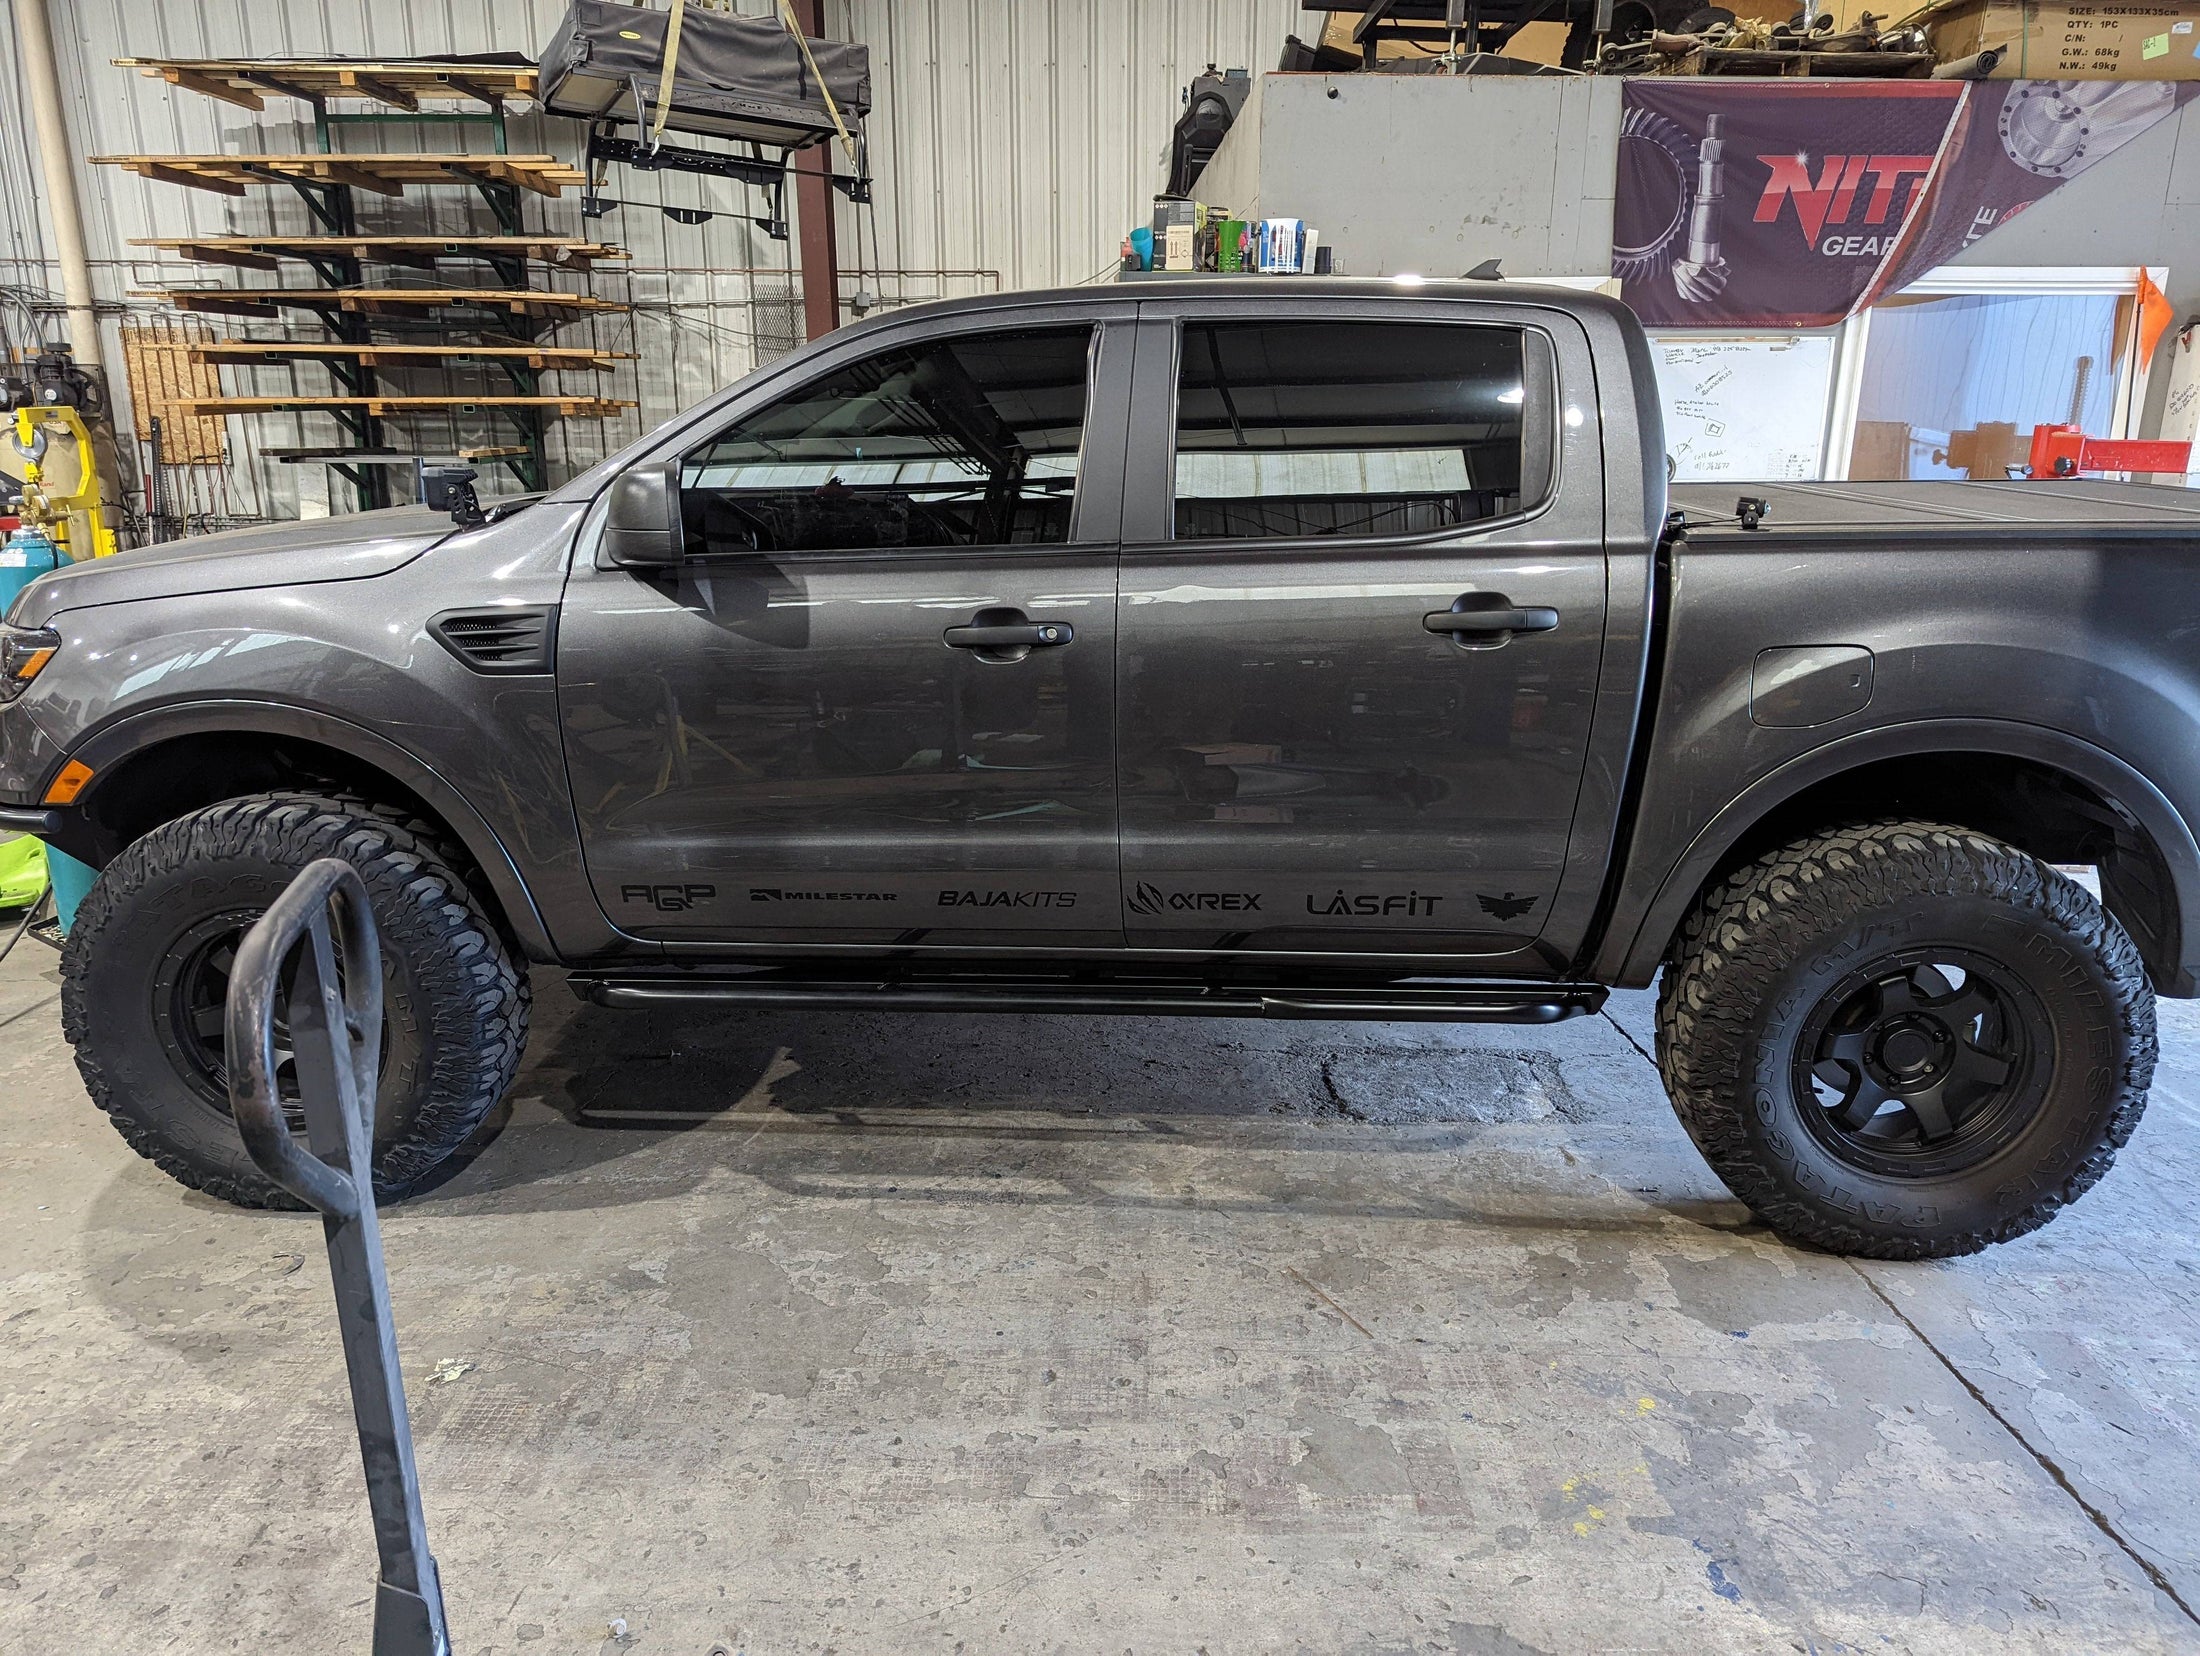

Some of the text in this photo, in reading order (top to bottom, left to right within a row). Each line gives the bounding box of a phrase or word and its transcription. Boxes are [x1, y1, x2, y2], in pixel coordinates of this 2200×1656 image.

[2068, 7, 2180, 16] SIZE: 153X133X35cm
[2067, 20, 2119, 28] QTY: 1PC
[2064, 34, 2086, 42] C/N:
[2061, 48, 2120, 57] G.W.: 68kg
[2059, 62, 2117, 71] N.W.: 49kg
[1753, 154, 1936, 250] NIT
[785, 891, 898, 901] MILESTAR
[1994, 931, 2114, 1202] MILESTAR
[1754, 987, 1942, 1229] PATAGONIA
